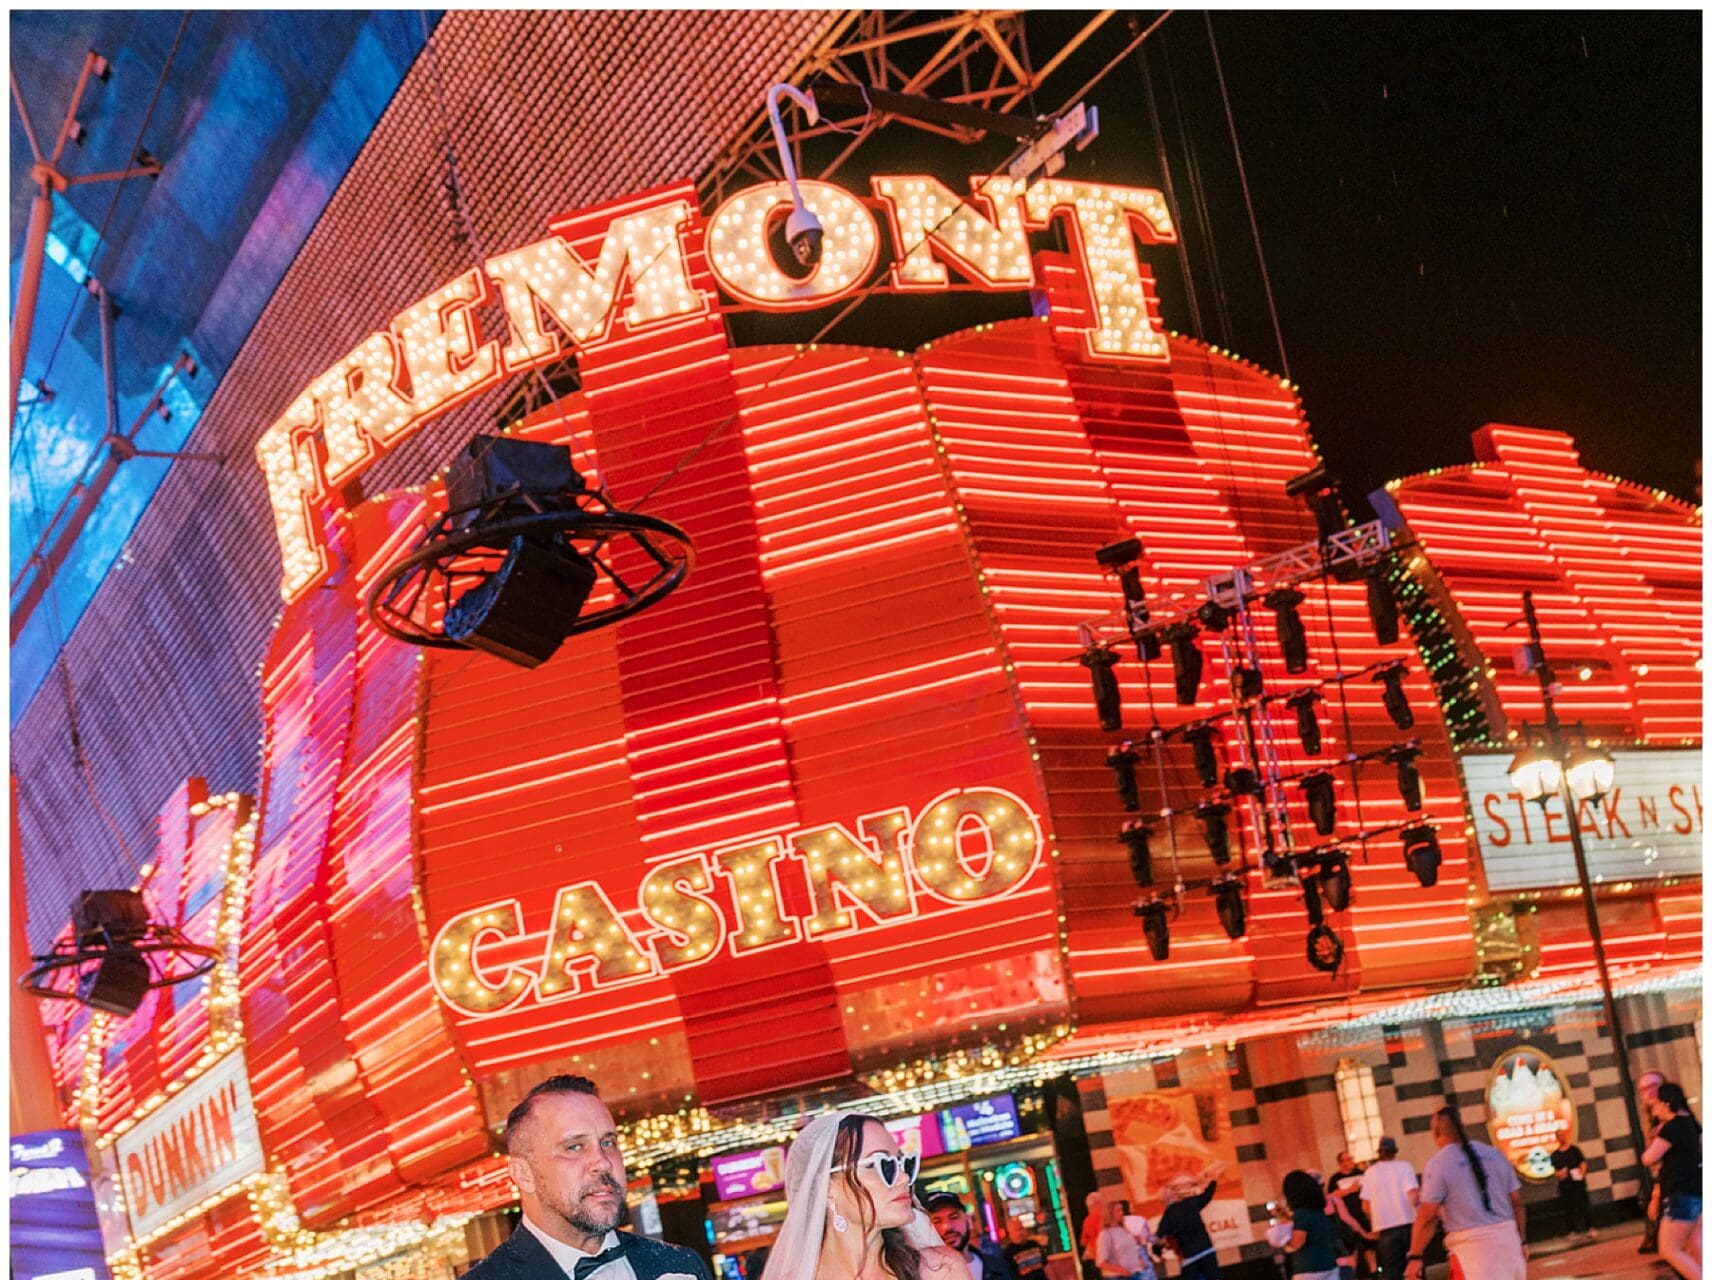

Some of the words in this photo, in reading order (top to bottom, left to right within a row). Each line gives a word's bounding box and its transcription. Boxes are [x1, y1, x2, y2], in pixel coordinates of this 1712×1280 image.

[257, 175, 1177, 602] FREMONT
[430, 787, 1043, 1018] CASINO
[1484, 788, 1632, 847] STEAK
[1638, 796, 1660, 829] N
[1668, 784, 1703, 836] S
[127, 1080, 237, 1217] DUNKIN'
